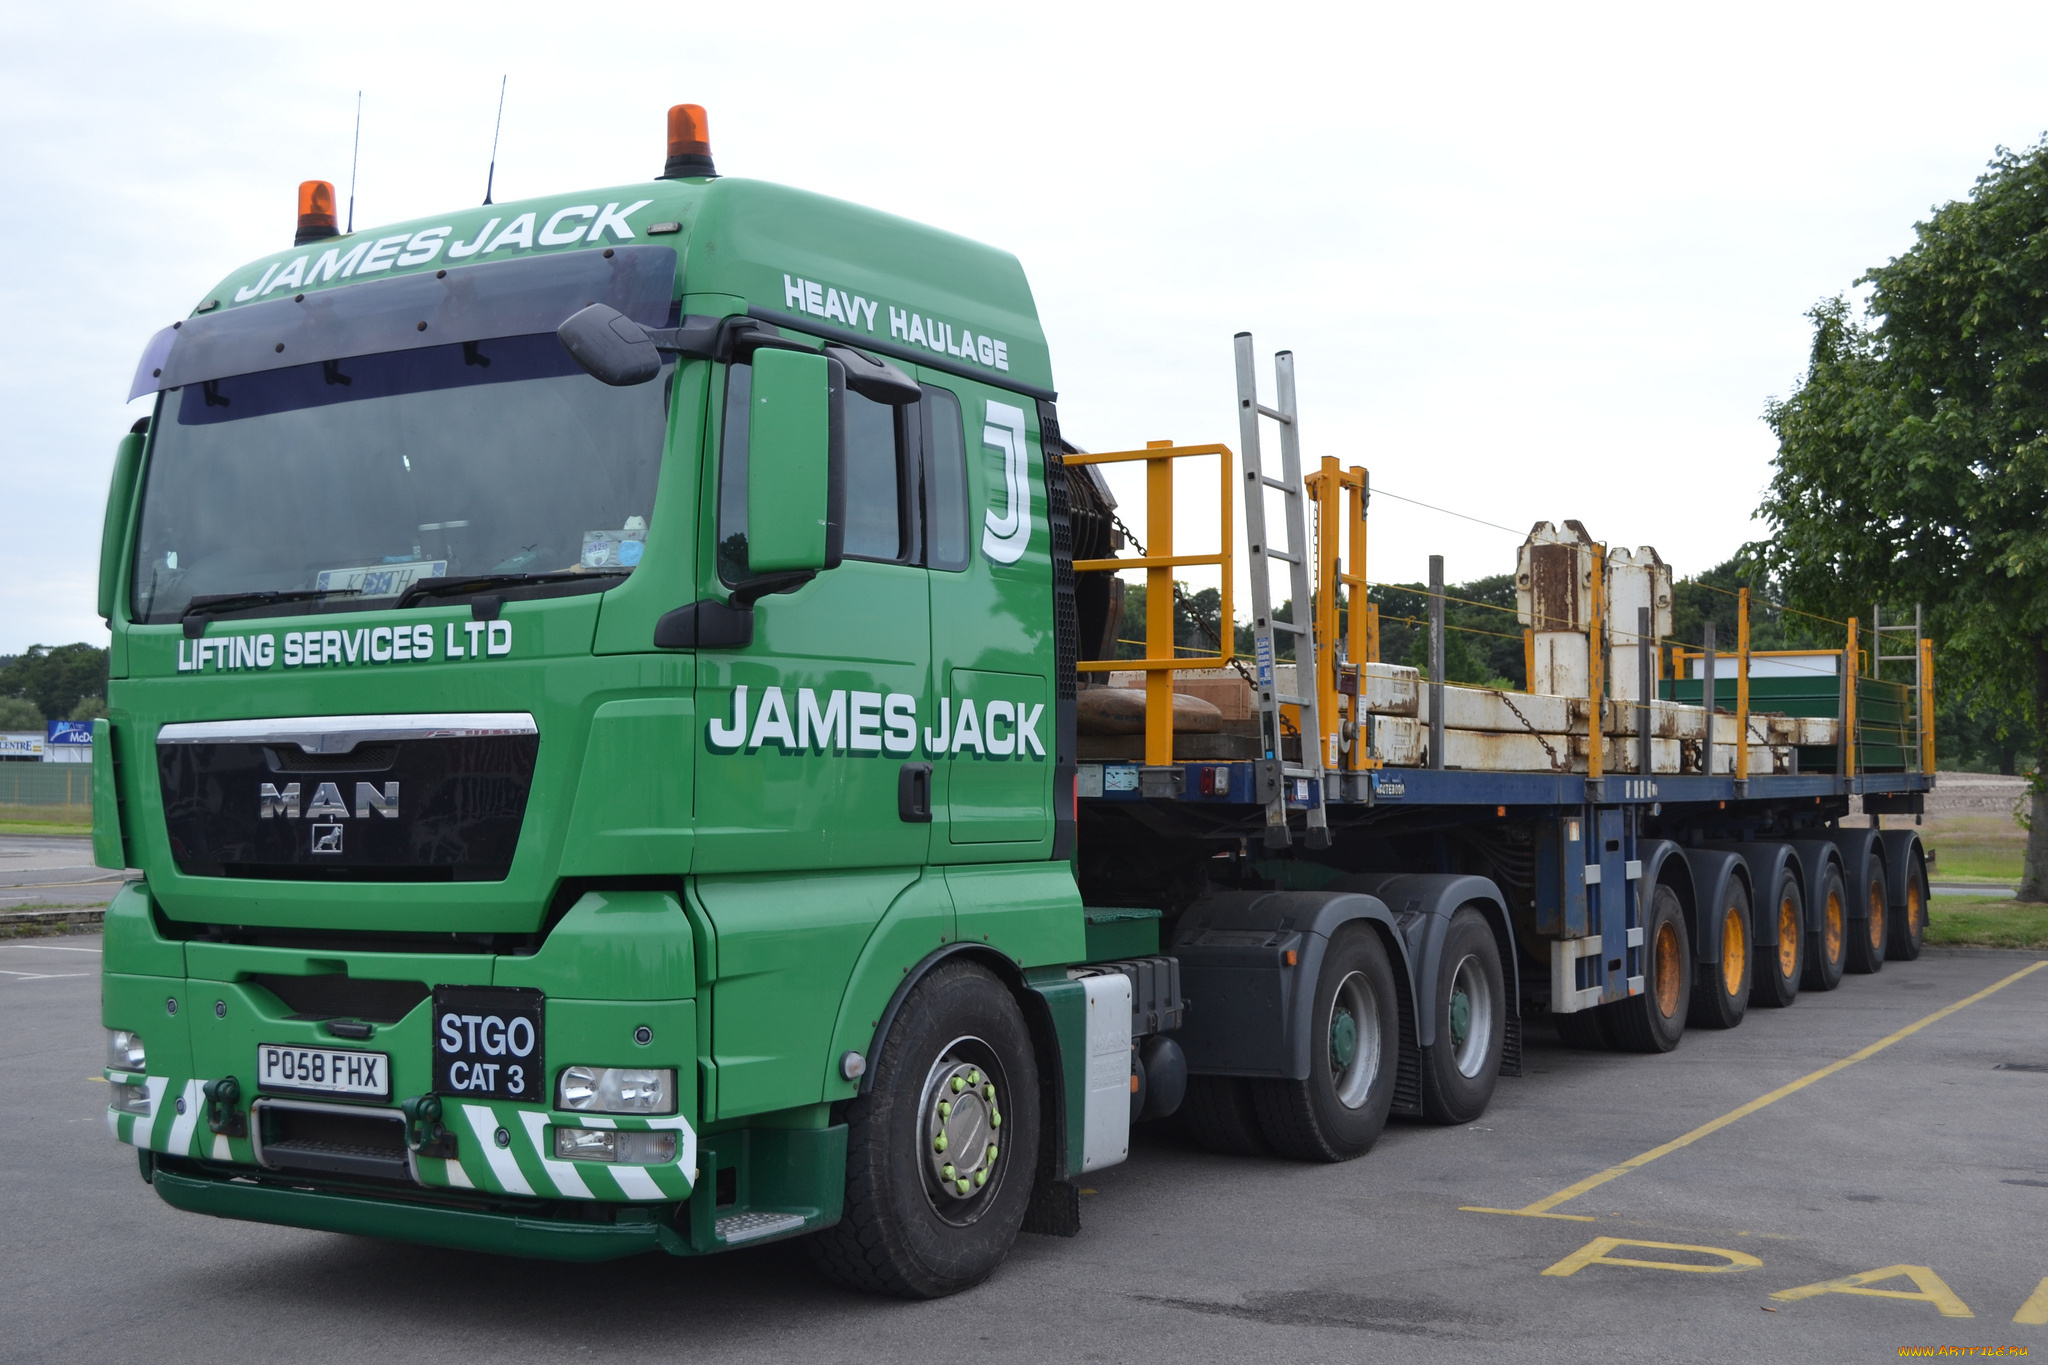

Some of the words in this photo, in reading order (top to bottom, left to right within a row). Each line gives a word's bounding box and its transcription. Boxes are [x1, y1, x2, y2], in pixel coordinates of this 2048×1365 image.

[234, 226, 452, 302] JAMES
[449, 200, 653, 258] JACK
[784, 274, 878, 331] HEAVY
[889, 306, 1009, 371] HAULAGE
[346, 569, 415, 596] KEITH
[178, 634, 275, 671] LIFTING
[284, 624, 434, 666] SERVICES
[447, 620, 512, 657] LTD
[709, 685, 917, 753] JAMES
[924, 697, 1047, 756] JACK
[261, 782, 400, 818] MAN
[440, 1013, 535, 1057] STGO
[332, 1055, 378, 1087] FHX
[450, 1061, 500, 1091] CAT
[507, 1064, 525, 1093] 3
